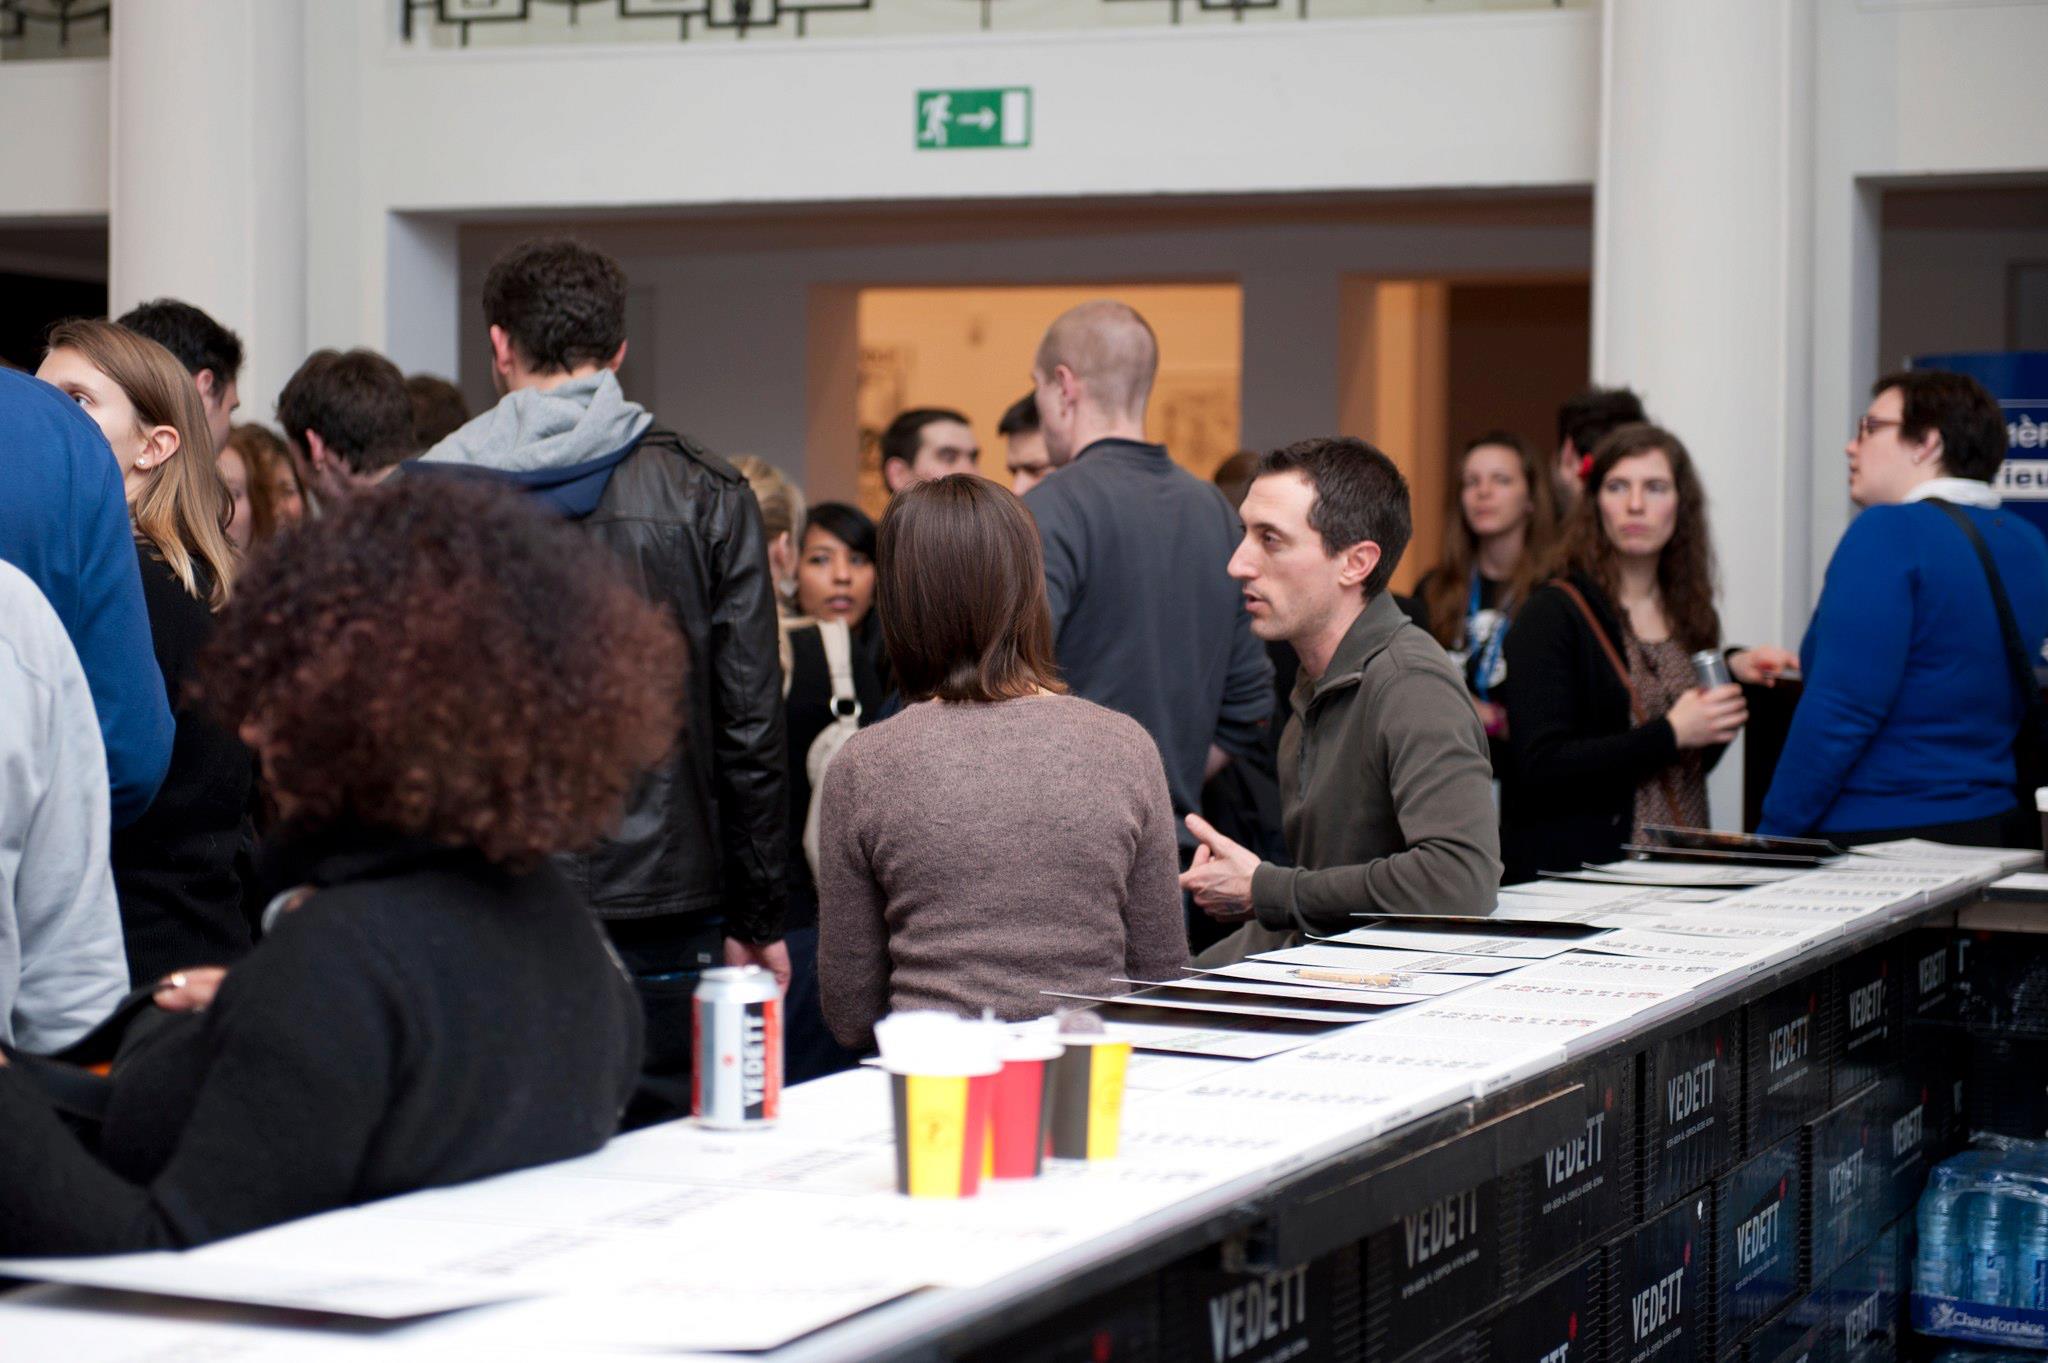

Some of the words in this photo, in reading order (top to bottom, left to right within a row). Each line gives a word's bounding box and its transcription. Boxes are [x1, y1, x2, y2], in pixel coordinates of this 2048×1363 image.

[1917, 947, 1947, 994] VEDETT
[1849, 978, 1883, 1031] VEDETT
[743, 1015, 764, 1107] VEDETT
[1769, 1014, 1809, 1074] VEDETT
[1668, 1059, 1715, 1125] VEDETT
[1545, 1112, 1604, 1189] VEDETT
[1893, 1104, 1923, 1158] VEDETT
[1829, 1147, 1864, 1208] VEDETT
[1404, 1187, 1477, 1269] VEDETT
[1737, 1200, 1780, 1269] VEDETT
[1209, 1265, 1309, 1363] VEDETT
[1632, 1266, 1684, 1344] VEDETT
